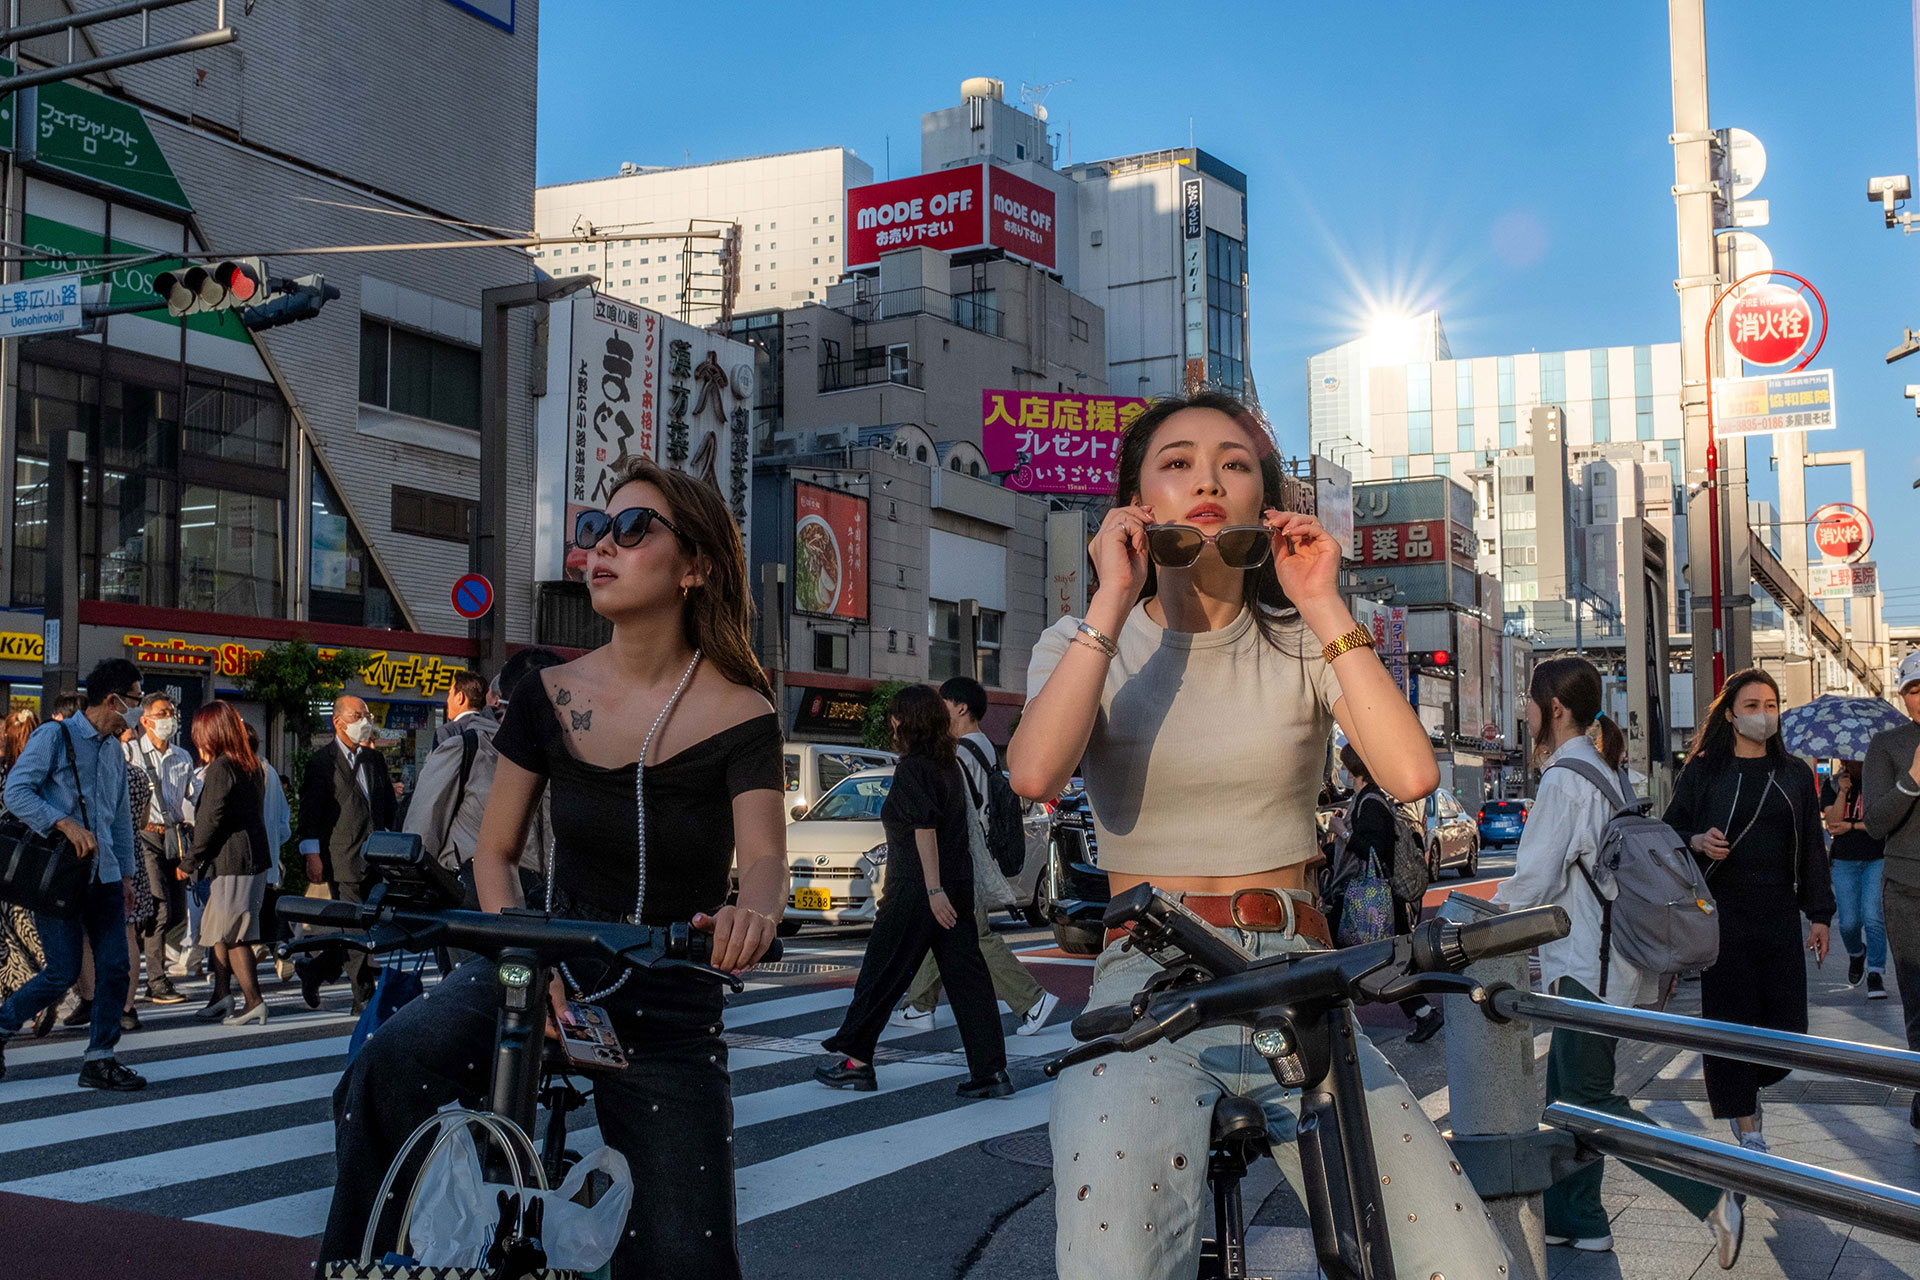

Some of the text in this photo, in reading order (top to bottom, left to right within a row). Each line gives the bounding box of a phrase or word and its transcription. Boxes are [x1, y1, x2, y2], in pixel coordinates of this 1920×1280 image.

[41, 102, 138, 148] フェイシャリスト
[857, 189, 973, 230] MODE OFF
[994, 193, 1051, 233] MODE OFF
[876, 220, 954, 247] お売り下さい
[1004, 219, 1043, 245] お売り下さい
[112, 268, 164, 298] COS
[0, 284, 77, 315] 上野広小路
[11, 311, 65, 328] Uenohirokoji
[595, 300, 639, 330] 立喰い鮨
[1735, 308, 1804, 343] 消火栓
[640, 314, 656, 458] サクッと本格江
[667, 339, 692, 472] 漢方薬
[574, 359, 588, 501] 上野広小路出張所
[1067, 483, 1087, 491] 15navi
[1819, 525, 1859, 545] 消火栓
[1827, 567, 1875, 588] 上野医院
[224, 645, 265, 675] Sho
[367, 654, 458, 693] マツモトキヨ
